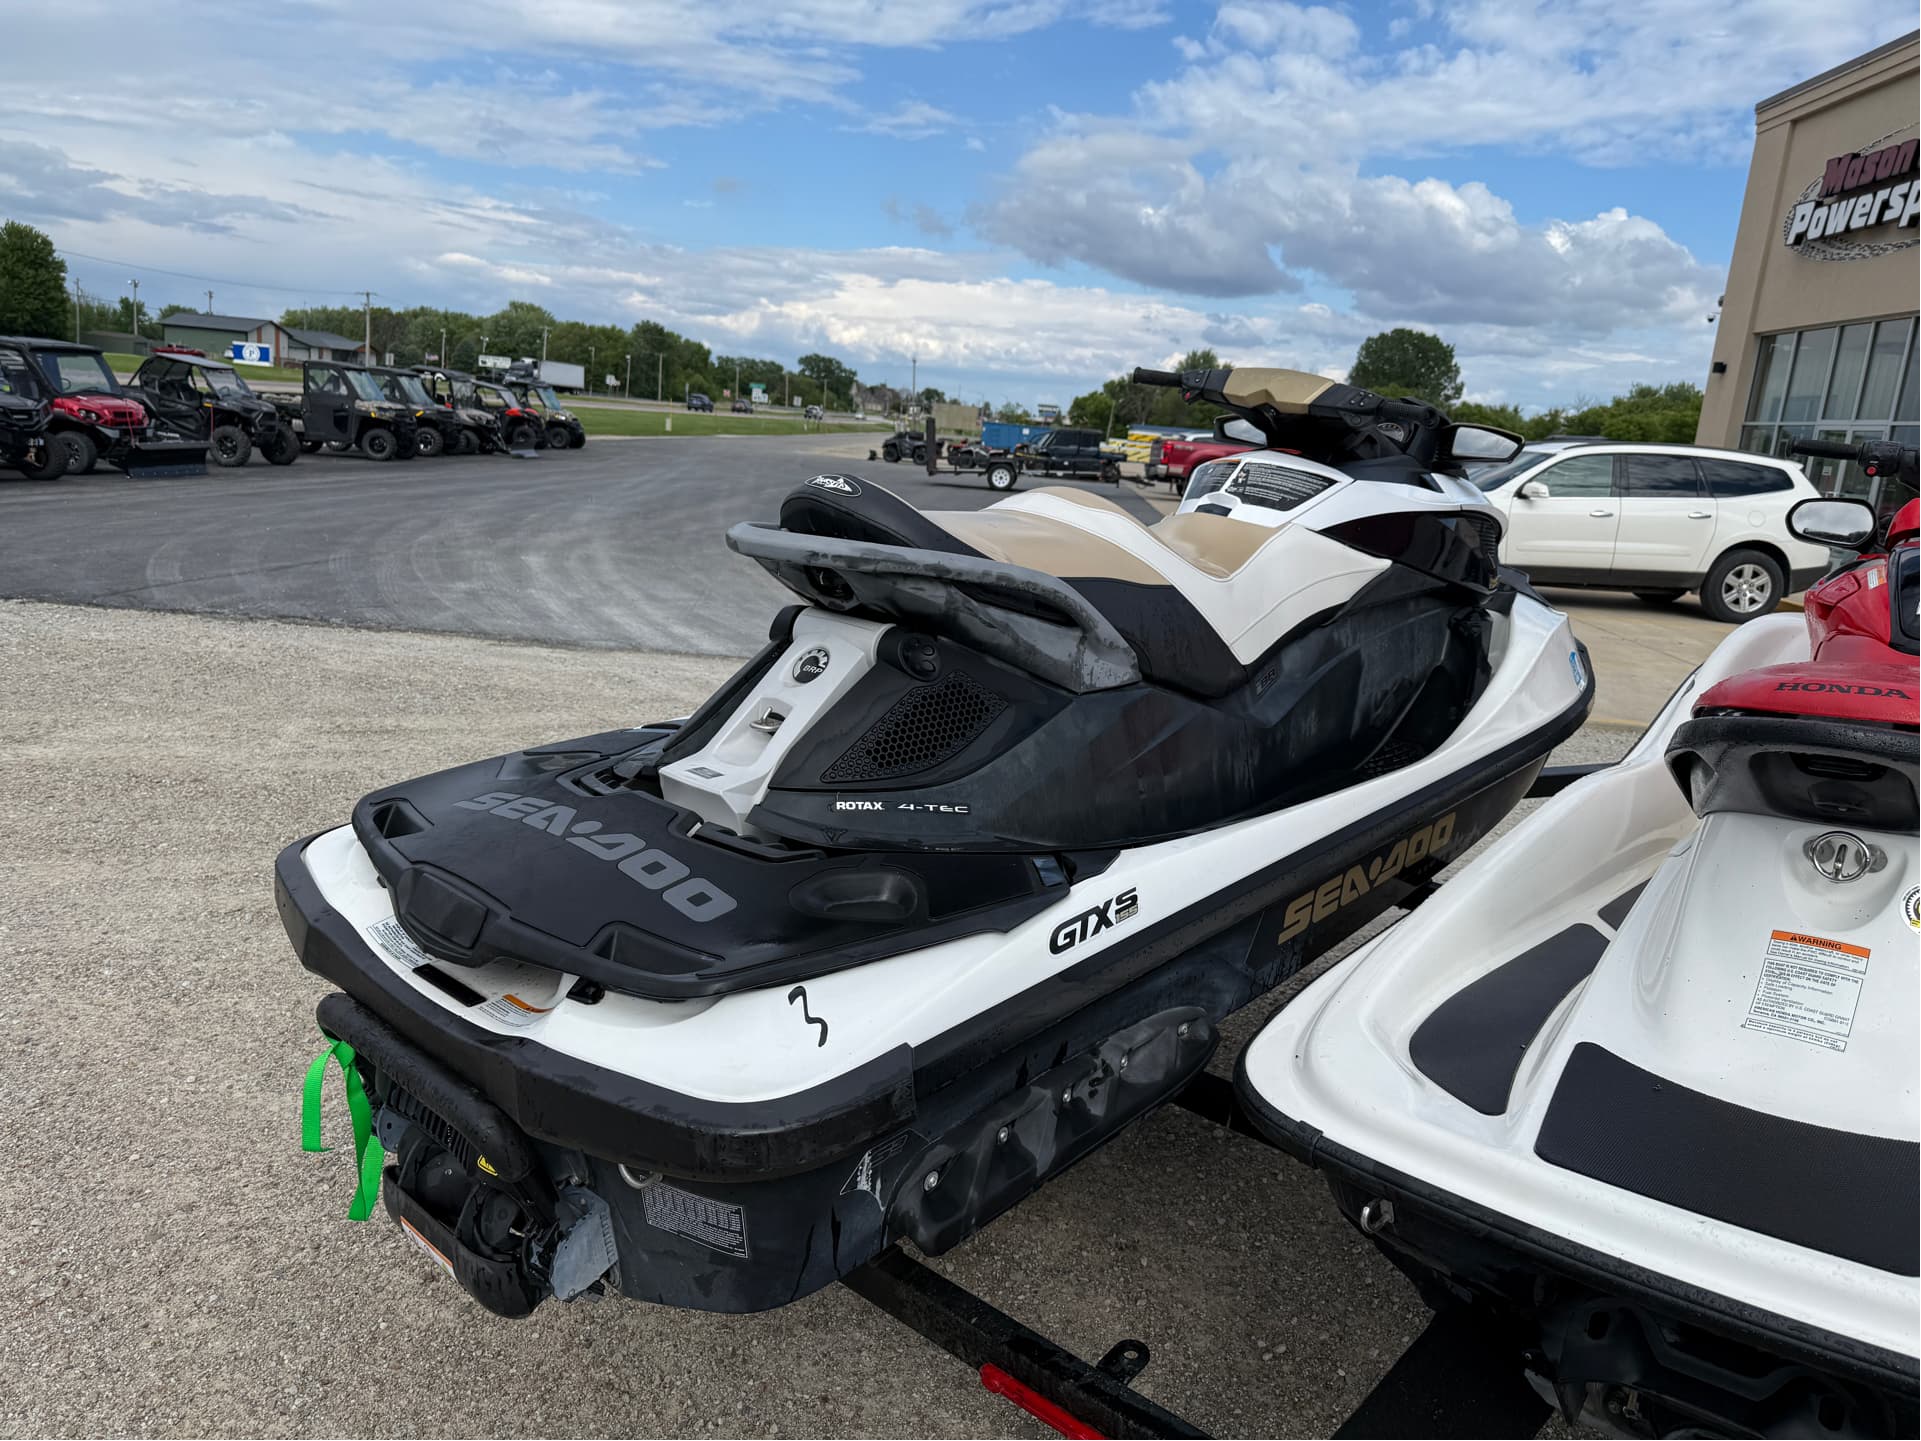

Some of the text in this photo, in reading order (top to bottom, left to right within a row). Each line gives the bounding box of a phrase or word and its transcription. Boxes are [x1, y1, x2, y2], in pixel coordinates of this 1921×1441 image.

[1819, 139, 1920, 198] Mason
[802, 664, 823, 675] BRP
[1776, 682, 1912, 700] HONDA
[836, 801, 969, 813] ROTAX 4-TEC
[1797, 935, 1842, 951] WARNING
